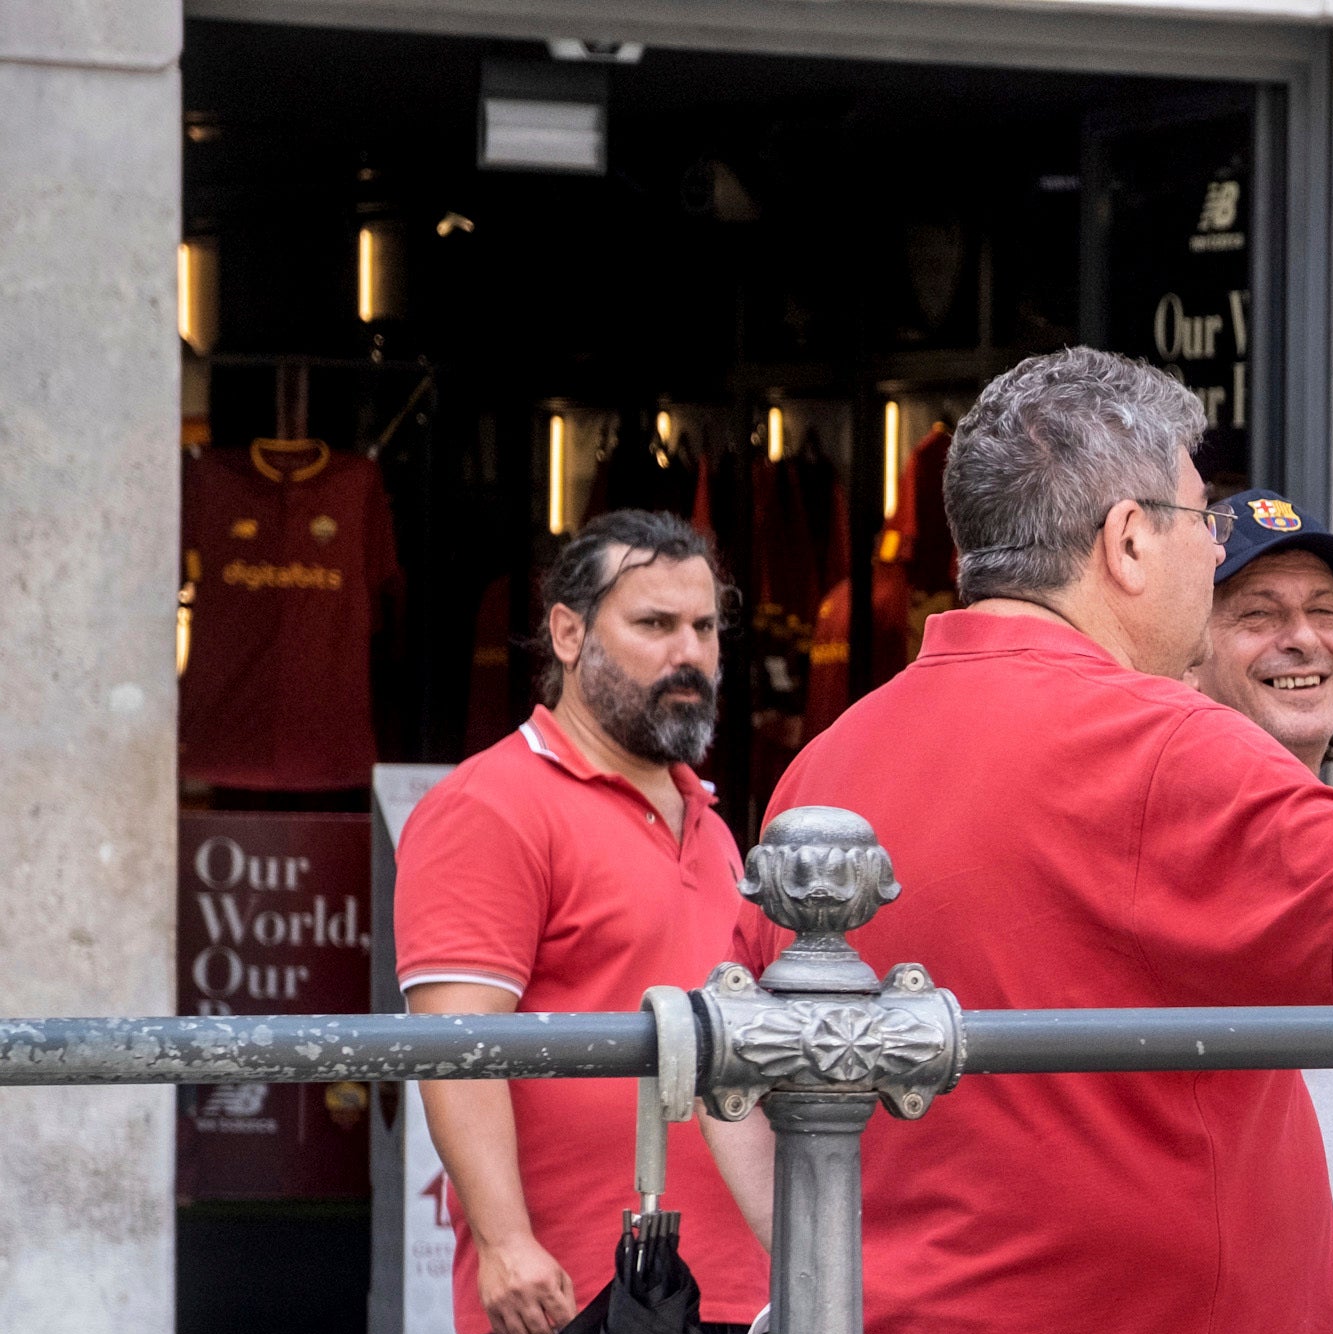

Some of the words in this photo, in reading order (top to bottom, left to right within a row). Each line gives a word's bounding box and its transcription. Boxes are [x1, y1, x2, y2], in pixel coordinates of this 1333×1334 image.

[1154, 292, 1223, 361] Our
[195, 836, 309, 891] Our
[198, 893, 371, 948] World,
[193, 945, 308, 1000] Our
